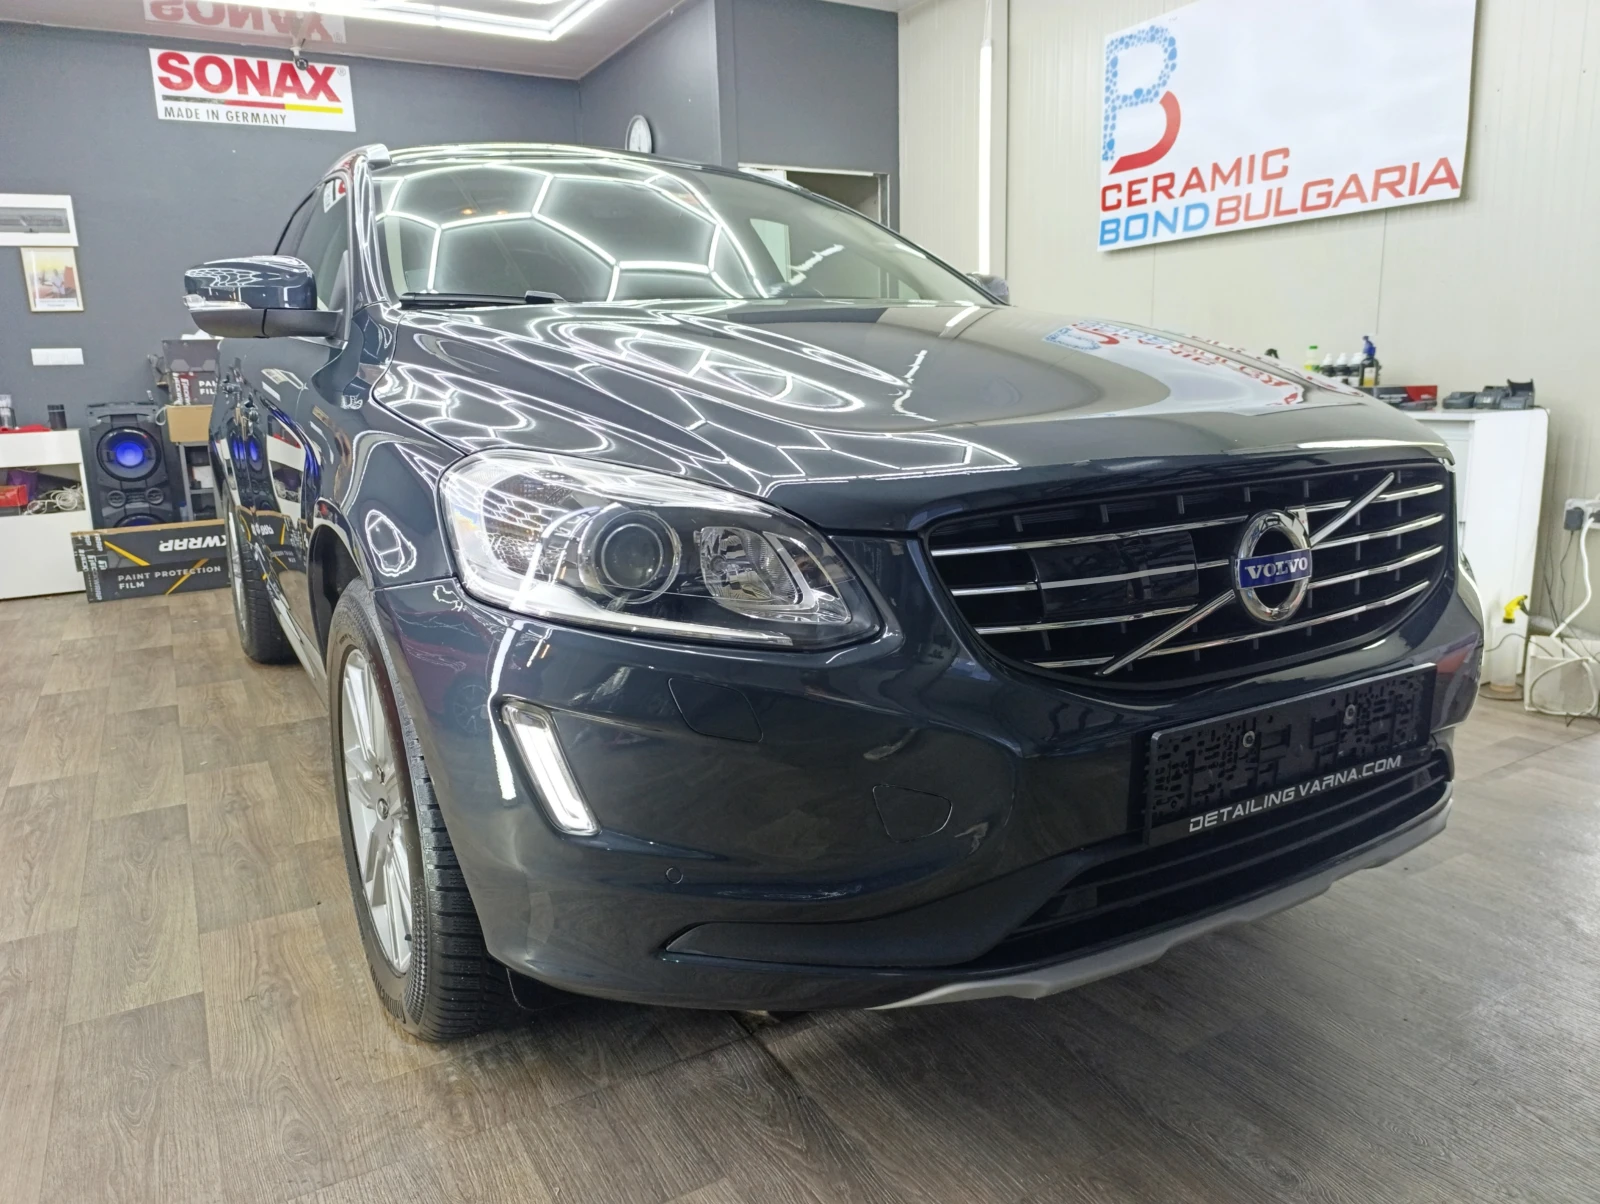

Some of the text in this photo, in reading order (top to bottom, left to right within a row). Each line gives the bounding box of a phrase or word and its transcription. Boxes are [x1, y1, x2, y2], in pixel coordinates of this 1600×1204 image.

[164, 106, 287, 125] MADE IN GERMANY
[1100, 147, 1290, 213] CERAMIC
[117, 565, 222, 582] PAINT PROTECTION
[1244, 557, 1308, 580] VOLVO
[118, 581, 145, 590] FILM
